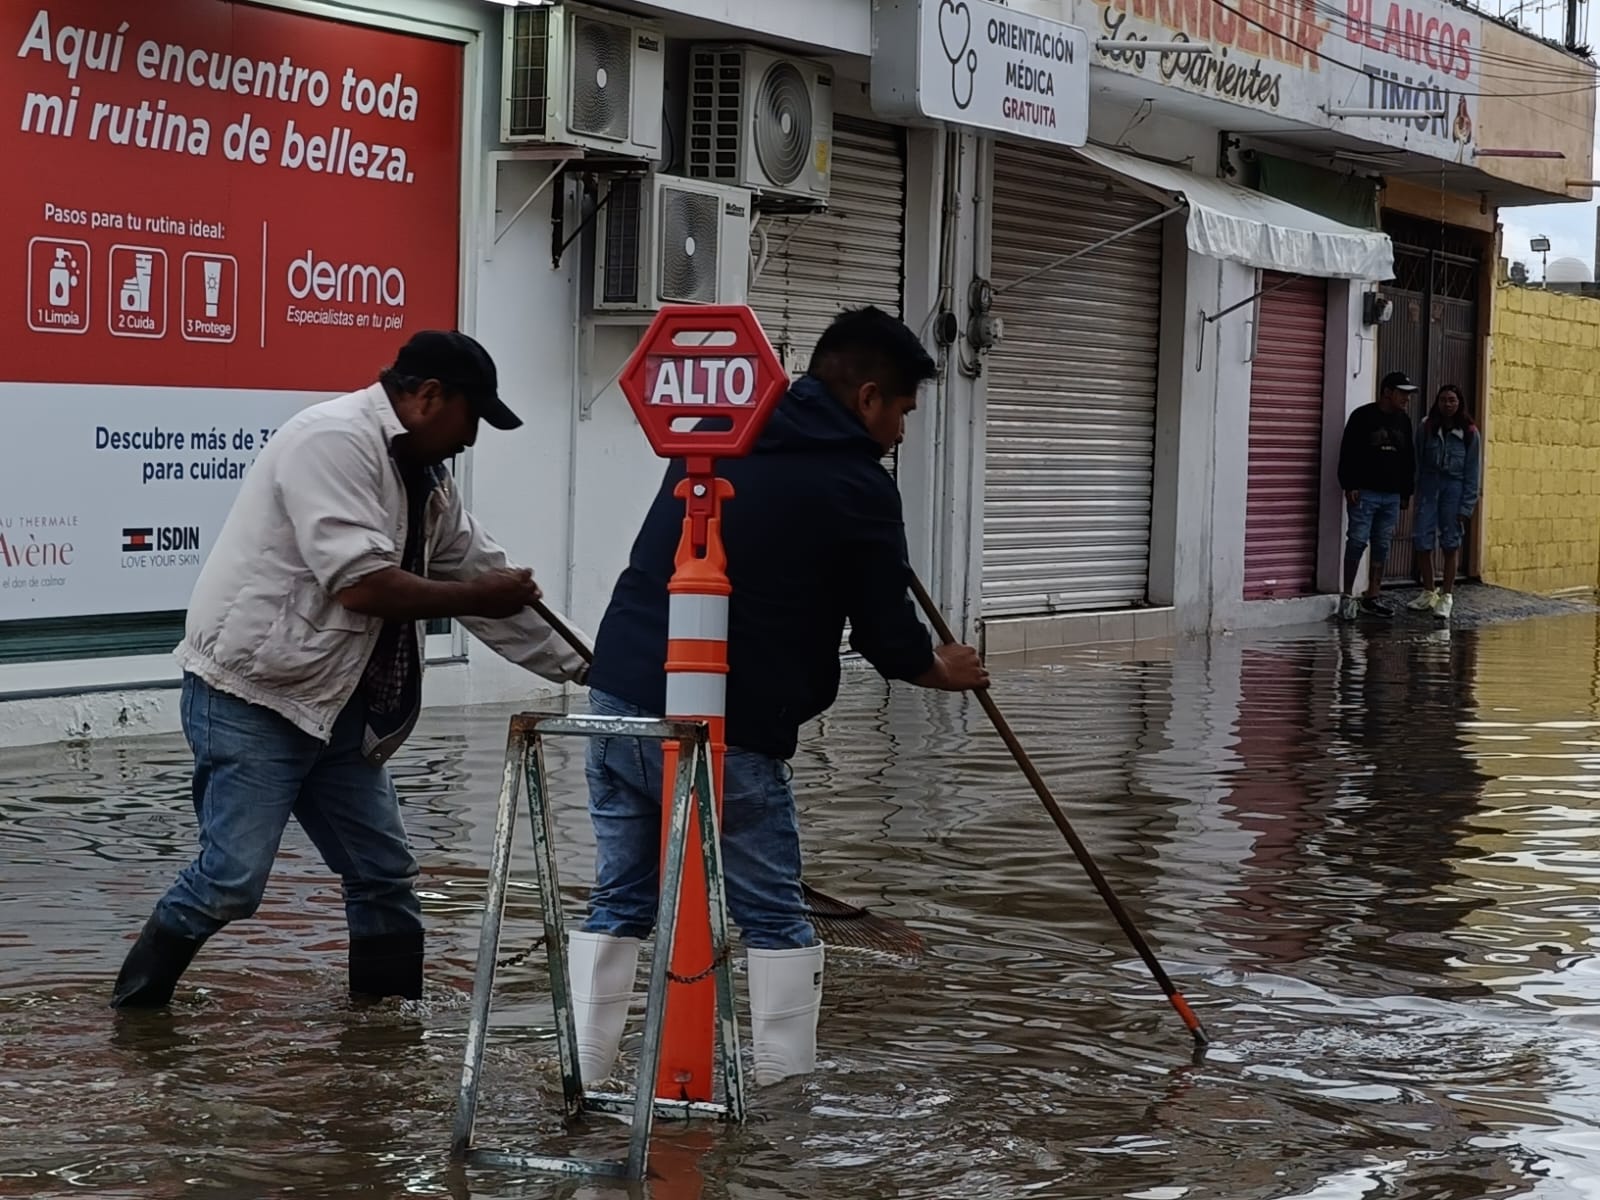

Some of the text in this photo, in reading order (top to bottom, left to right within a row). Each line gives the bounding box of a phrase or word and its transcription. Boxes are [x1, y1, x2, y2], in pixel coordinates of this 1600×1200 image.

[987, 18, 1074, 64] ORIENTACIÓN
[1346, 0, 1471, 80] BLANCOS
[17, 10, 419, 121] Aquí encuentro toda
[1006, 59, 1054, 97] MÉDICA
[1160, 31, 1281, 108] Parientes
[1002, 96, 1056, 128] GRATUITA
[1363, 64, 1450, 139] TIMÓN
[20, 87, 415, 184] mi rutina de belleza.
[45, 203, 225, 239] Pasos para tu rutina ideal:
[287, 249, 405, 306] derma
[38, 309, 80, 326] 1 Limpia
[118, 314, 155, 330] 2 Cuida
[187, 319, 232, 337] 3 Protege
[286, 305, 404, 331] Especialistas en tu piel
[651, 357, 754, 405] ALTO
[95, 426, 278, 450] Descubre más de 3
[142, 458, 246, 484] para cuidar
[20, 515, 79, 528] THERMALE
[157, 526, 199, 551] ISDIN
[0, 532, 74, 567] Avène
[121, 554, 200, 568] LOVE YOUR SKIN
